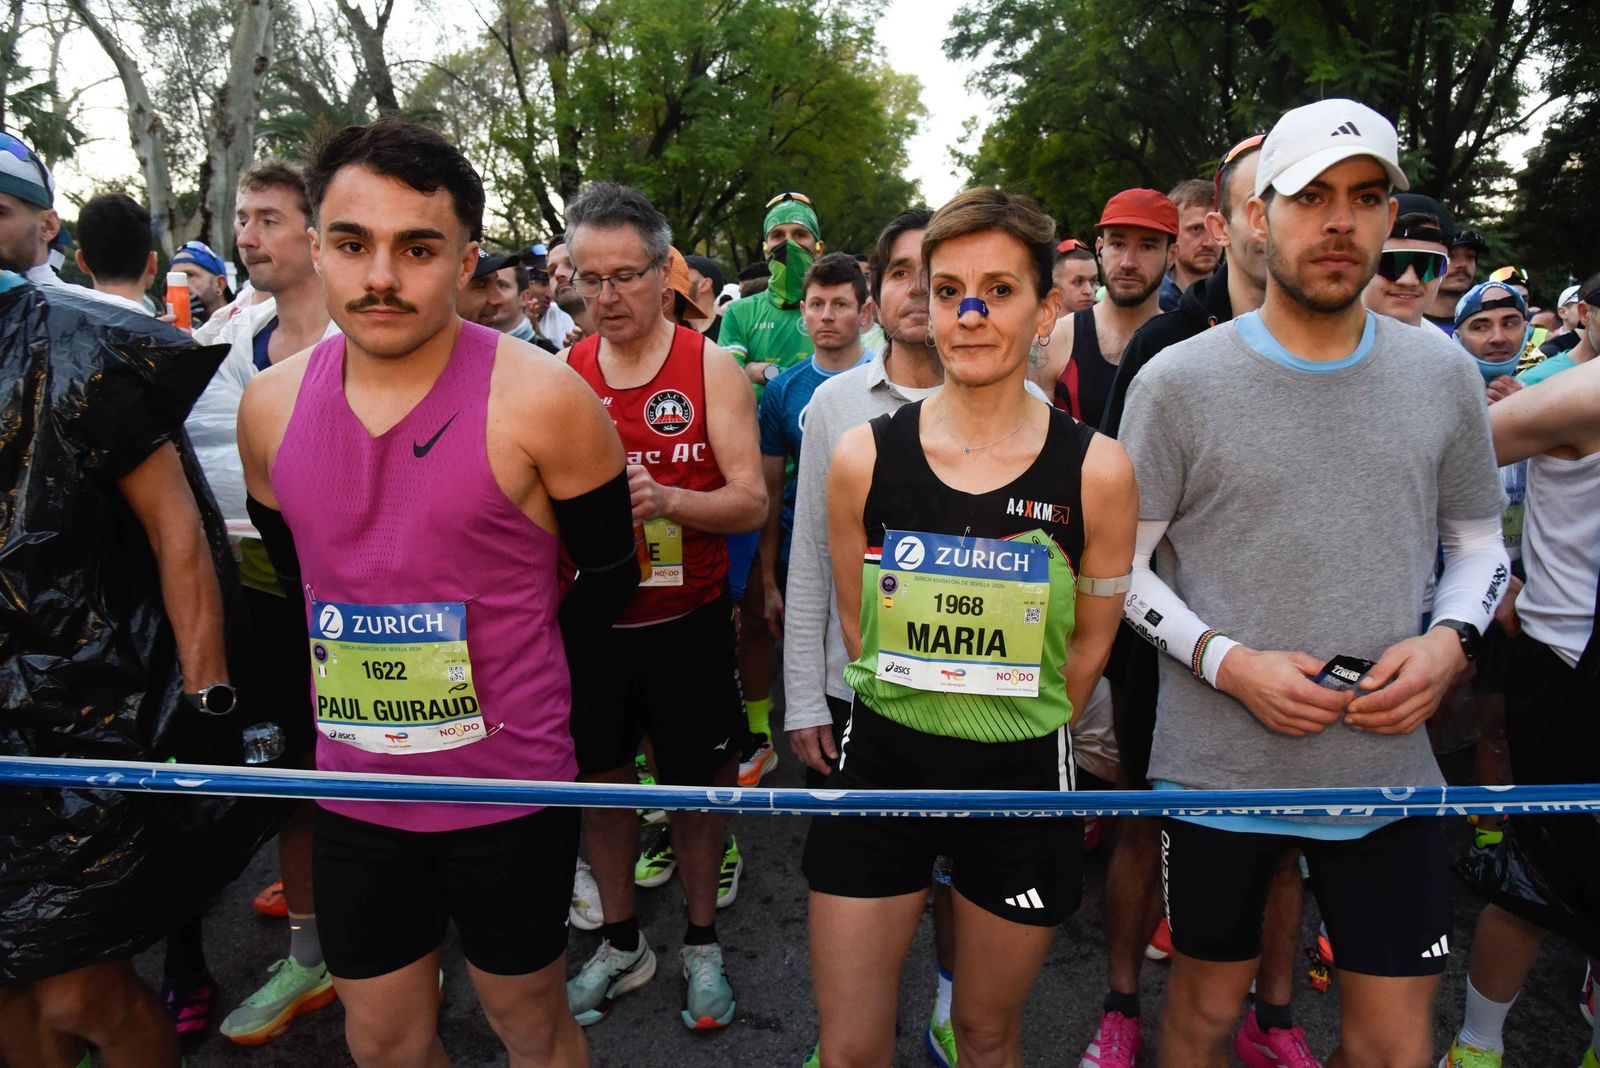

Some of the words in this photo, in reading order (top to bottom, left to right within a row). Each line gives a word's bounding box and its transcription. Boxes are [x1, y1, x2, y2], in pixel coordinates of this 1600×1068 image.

[671, 442, 706, 463] AC
[1006, 498, 1053, 522] A4XKM
[648, 542, 661, 561] E
[935, 547, 1029, 572] ZURICH
[934, 593, 984, 616] 1968
[352, 613, 443, 635] ZURICH
[907, 621, 1007, 657] MARIA
[362, 660, 408, 680] 1622
[893, 665, 910, 675] asics
[317, 695, 368, 720] PAUL
[373, 695, 478, 722] GUIRAUD
[337, 732, 356, 741] asics
